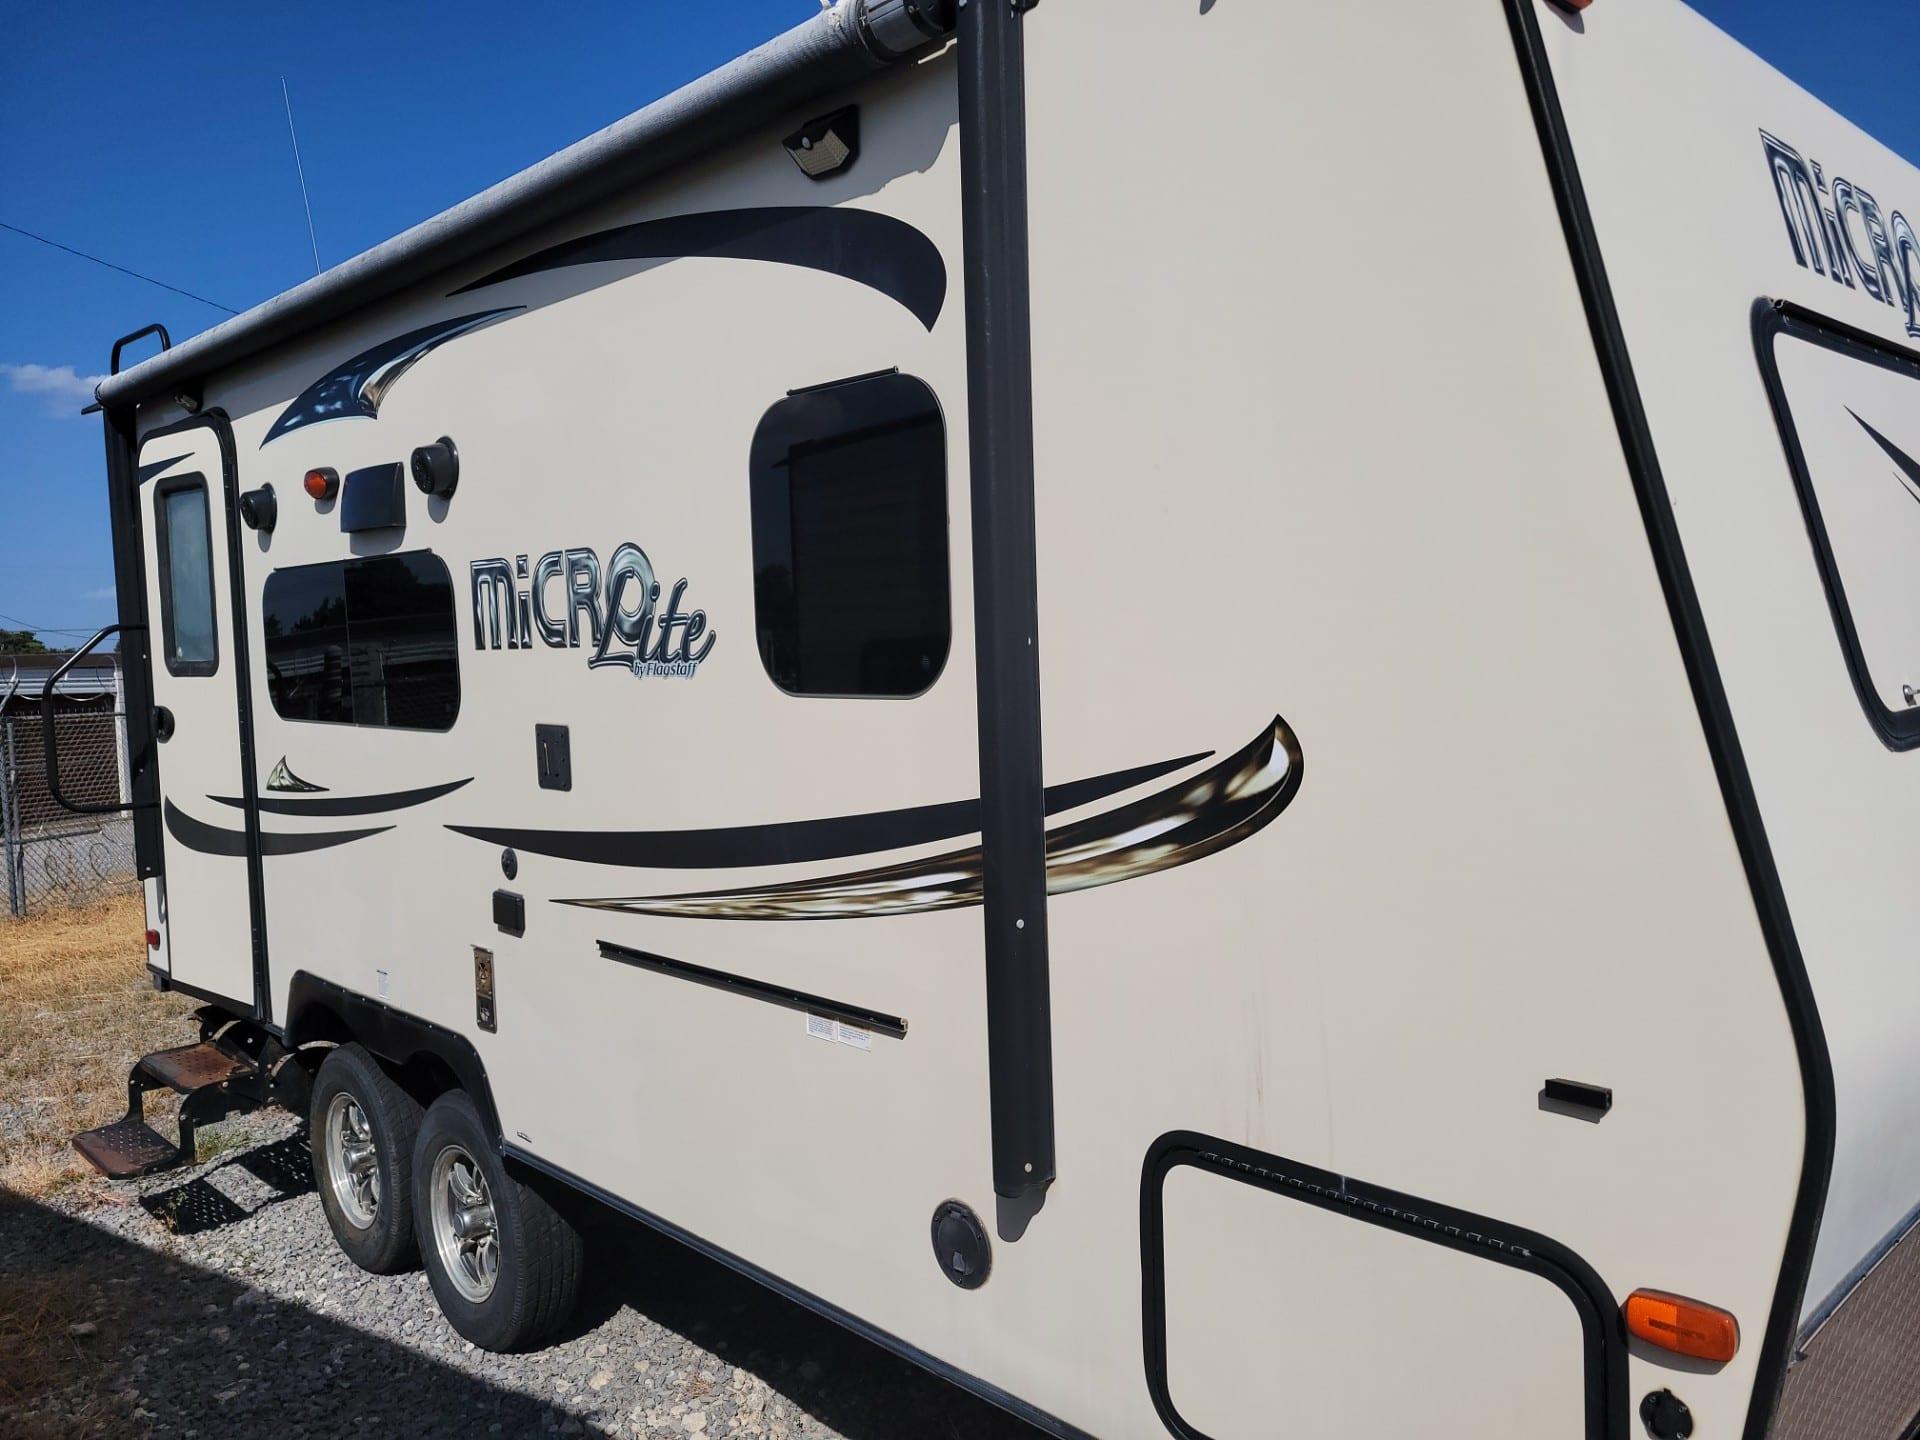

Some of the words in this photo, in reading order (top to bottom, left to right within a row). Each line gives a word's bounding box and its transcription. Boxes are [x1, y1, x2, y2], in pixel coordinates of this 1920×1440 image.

[588, 567, 717, 671] Lite
[634, 661, 646, 679] by
[646, 661, 698, 678] Flagstaff
